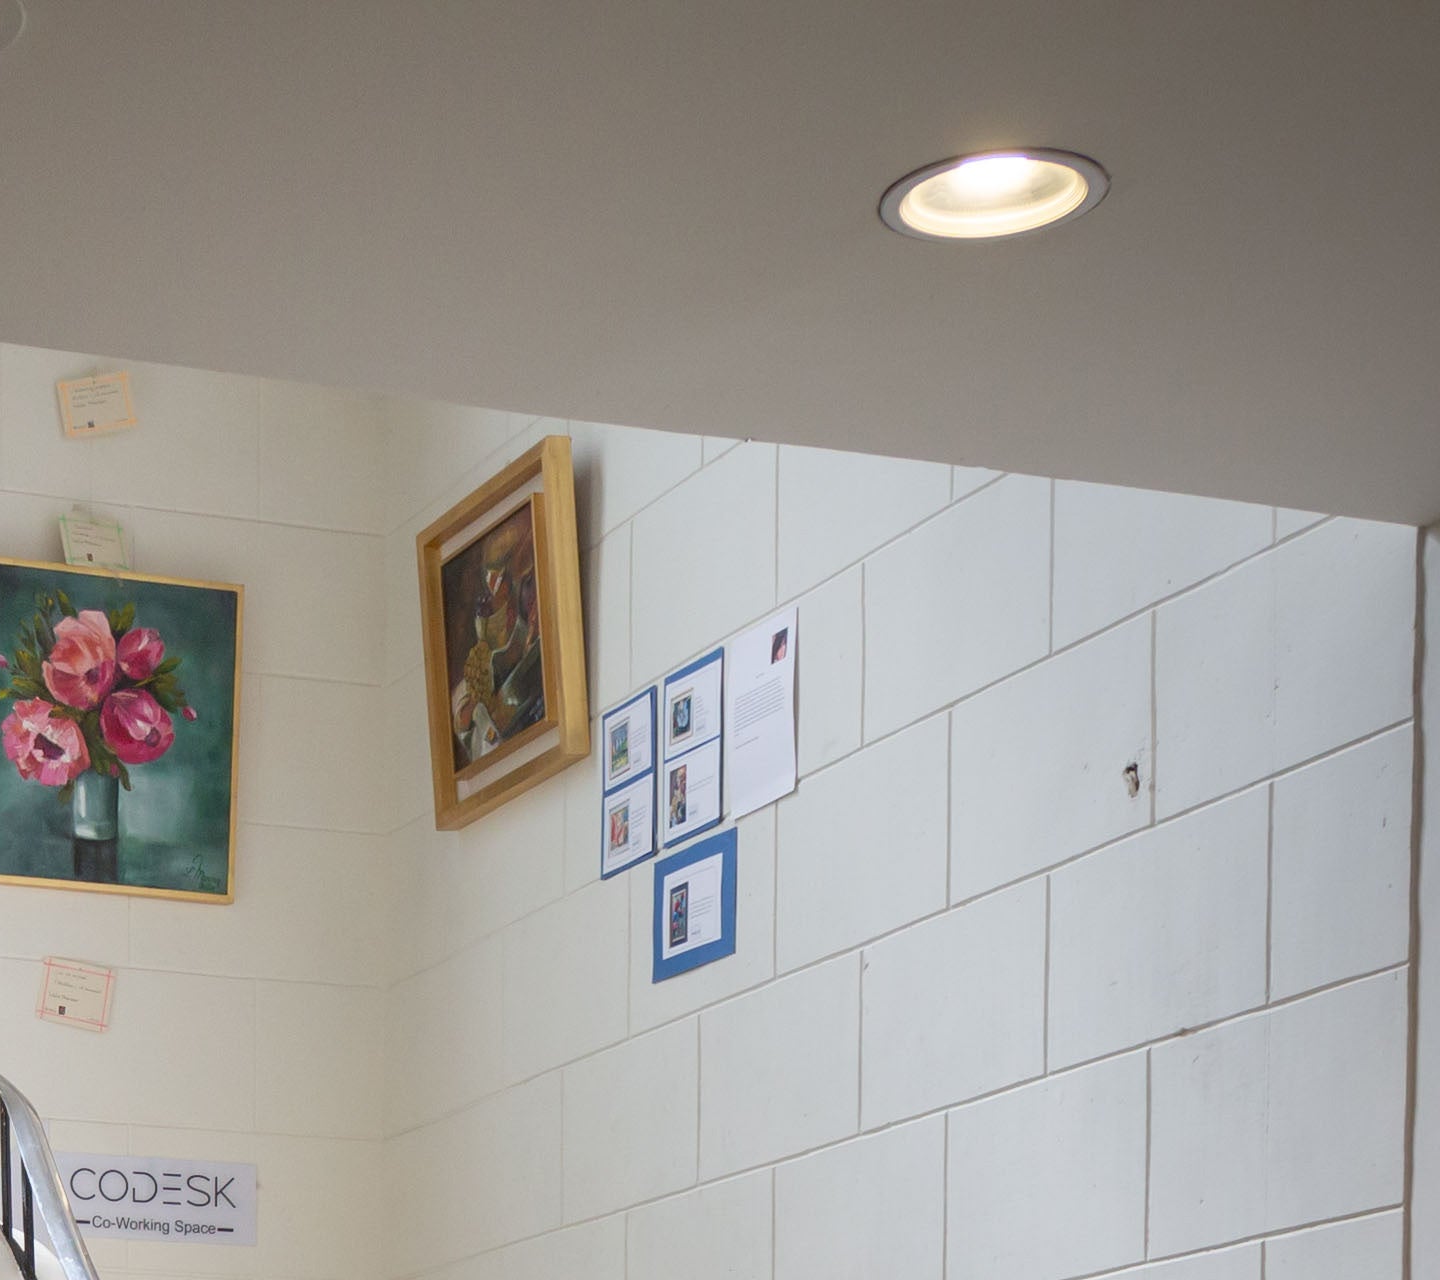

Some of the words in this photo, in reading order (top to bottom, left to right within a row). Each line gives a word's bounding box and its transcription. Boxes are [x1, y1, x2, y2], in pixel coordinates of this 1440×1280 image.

[70, 1168, 236, 1208] CODESK
[92, 1215, 170, 1234] Co-Working
[175, 1219, 216, 1235] Space
